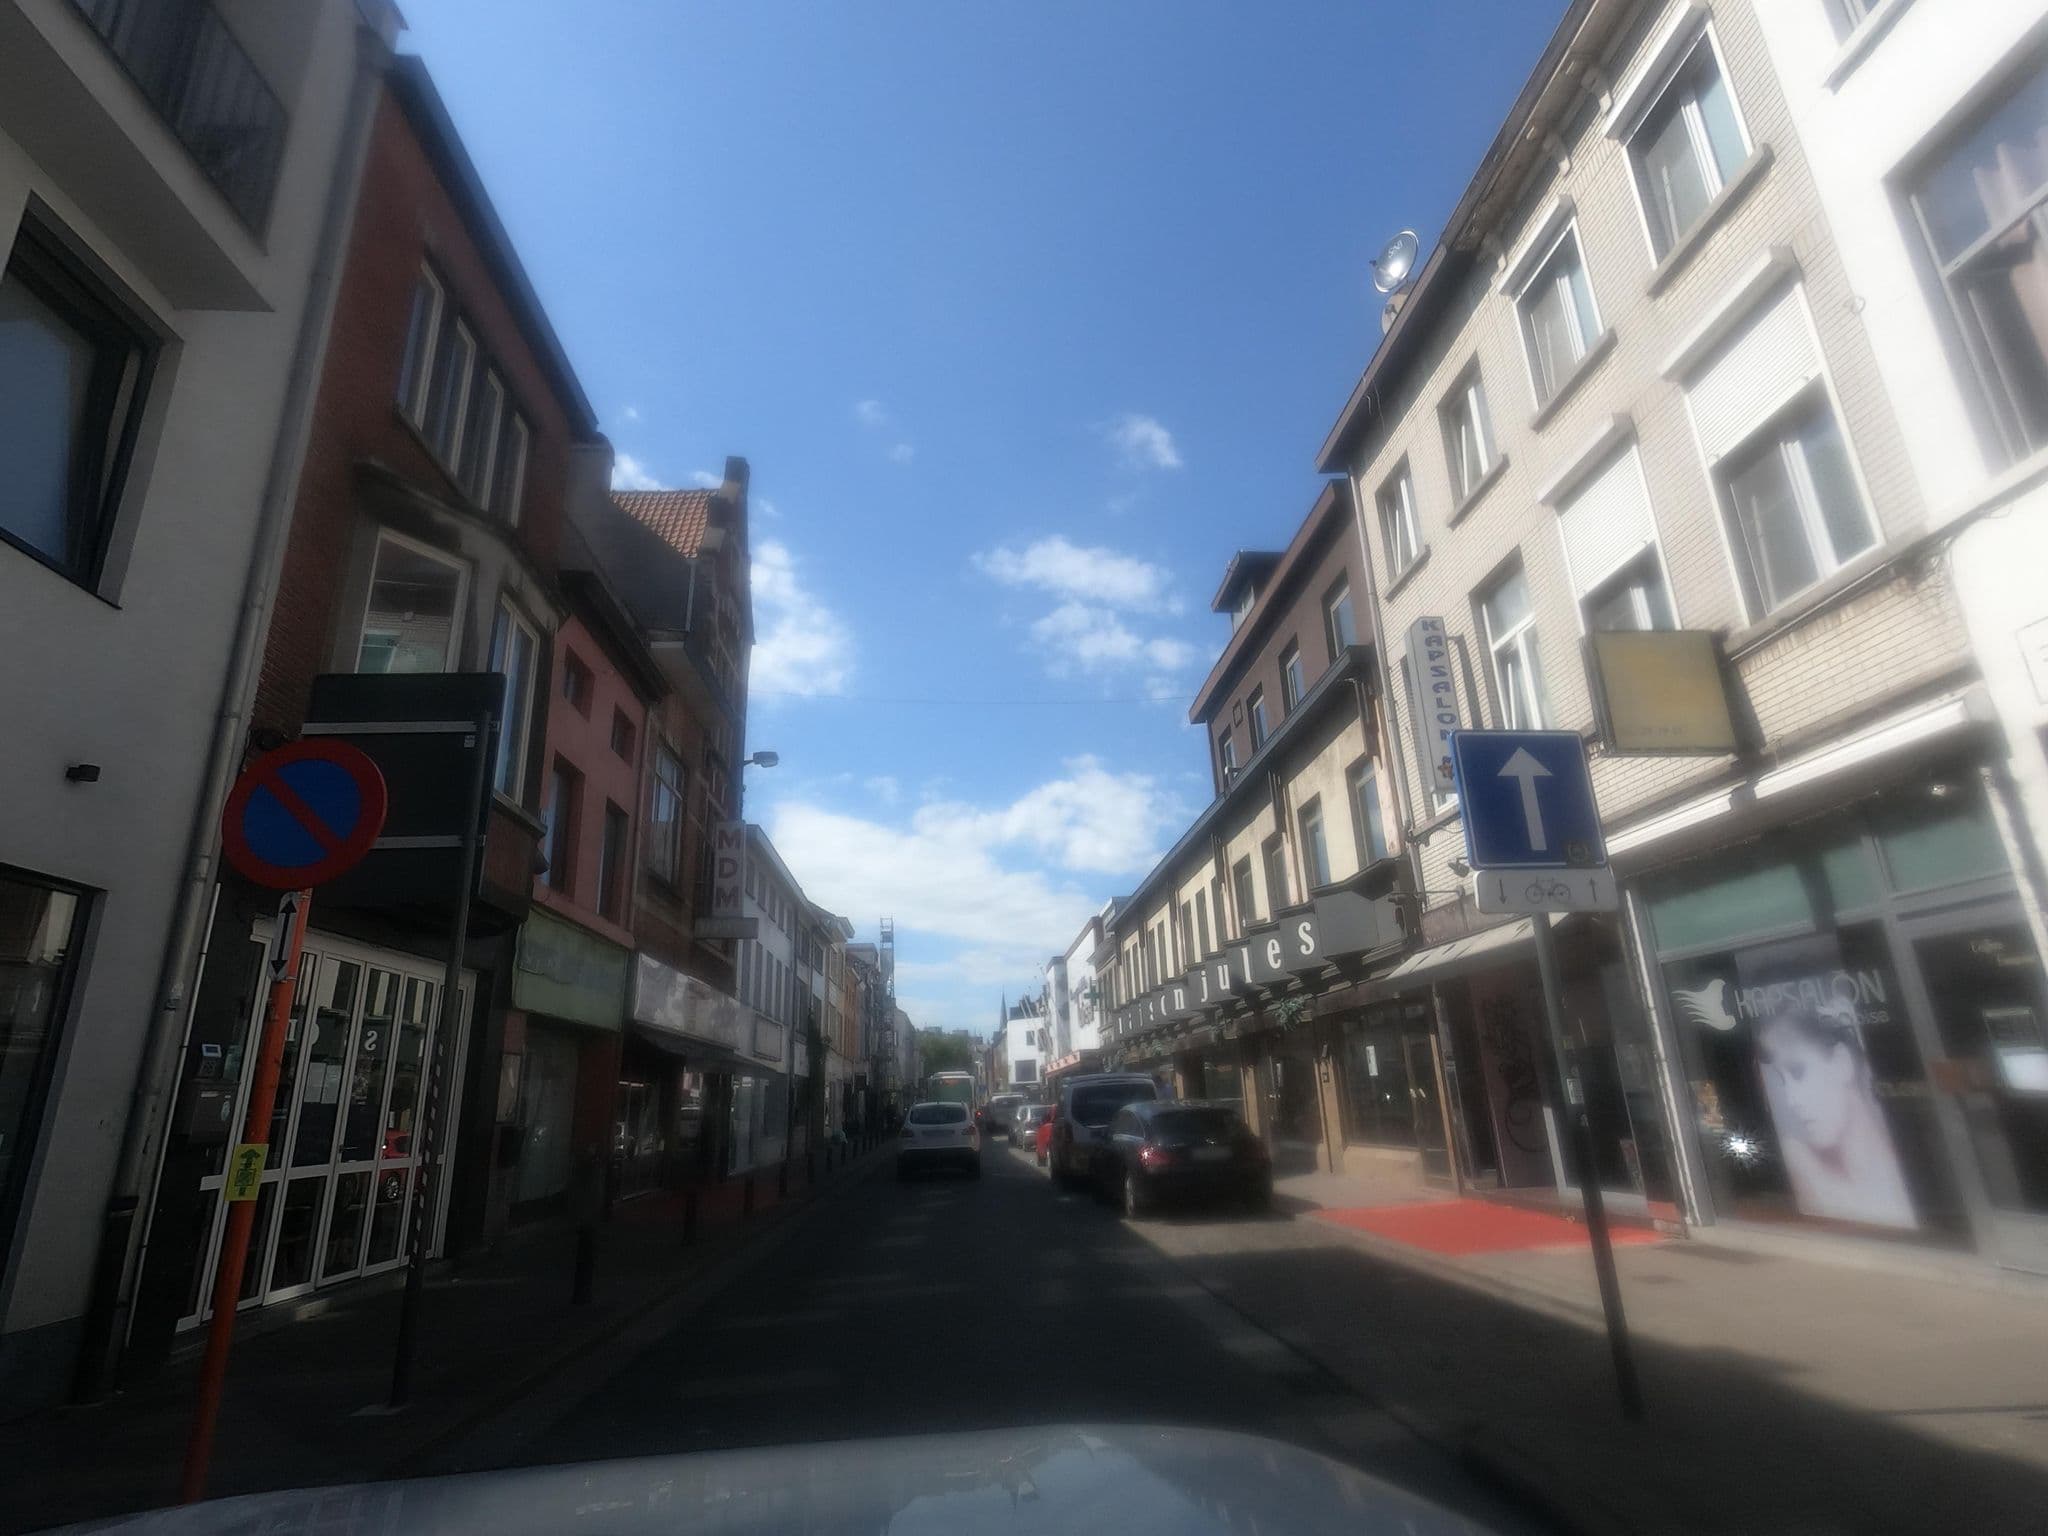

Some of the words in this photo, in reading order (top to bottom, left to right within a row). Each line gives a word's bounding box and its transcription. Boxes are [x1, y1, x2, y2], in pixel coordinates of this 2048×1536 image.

[716, 829, 740, 908] MDM
[1200, 921, 1315, 1002] jules
[1734, 968, 1887, 1019] KAPSALON
